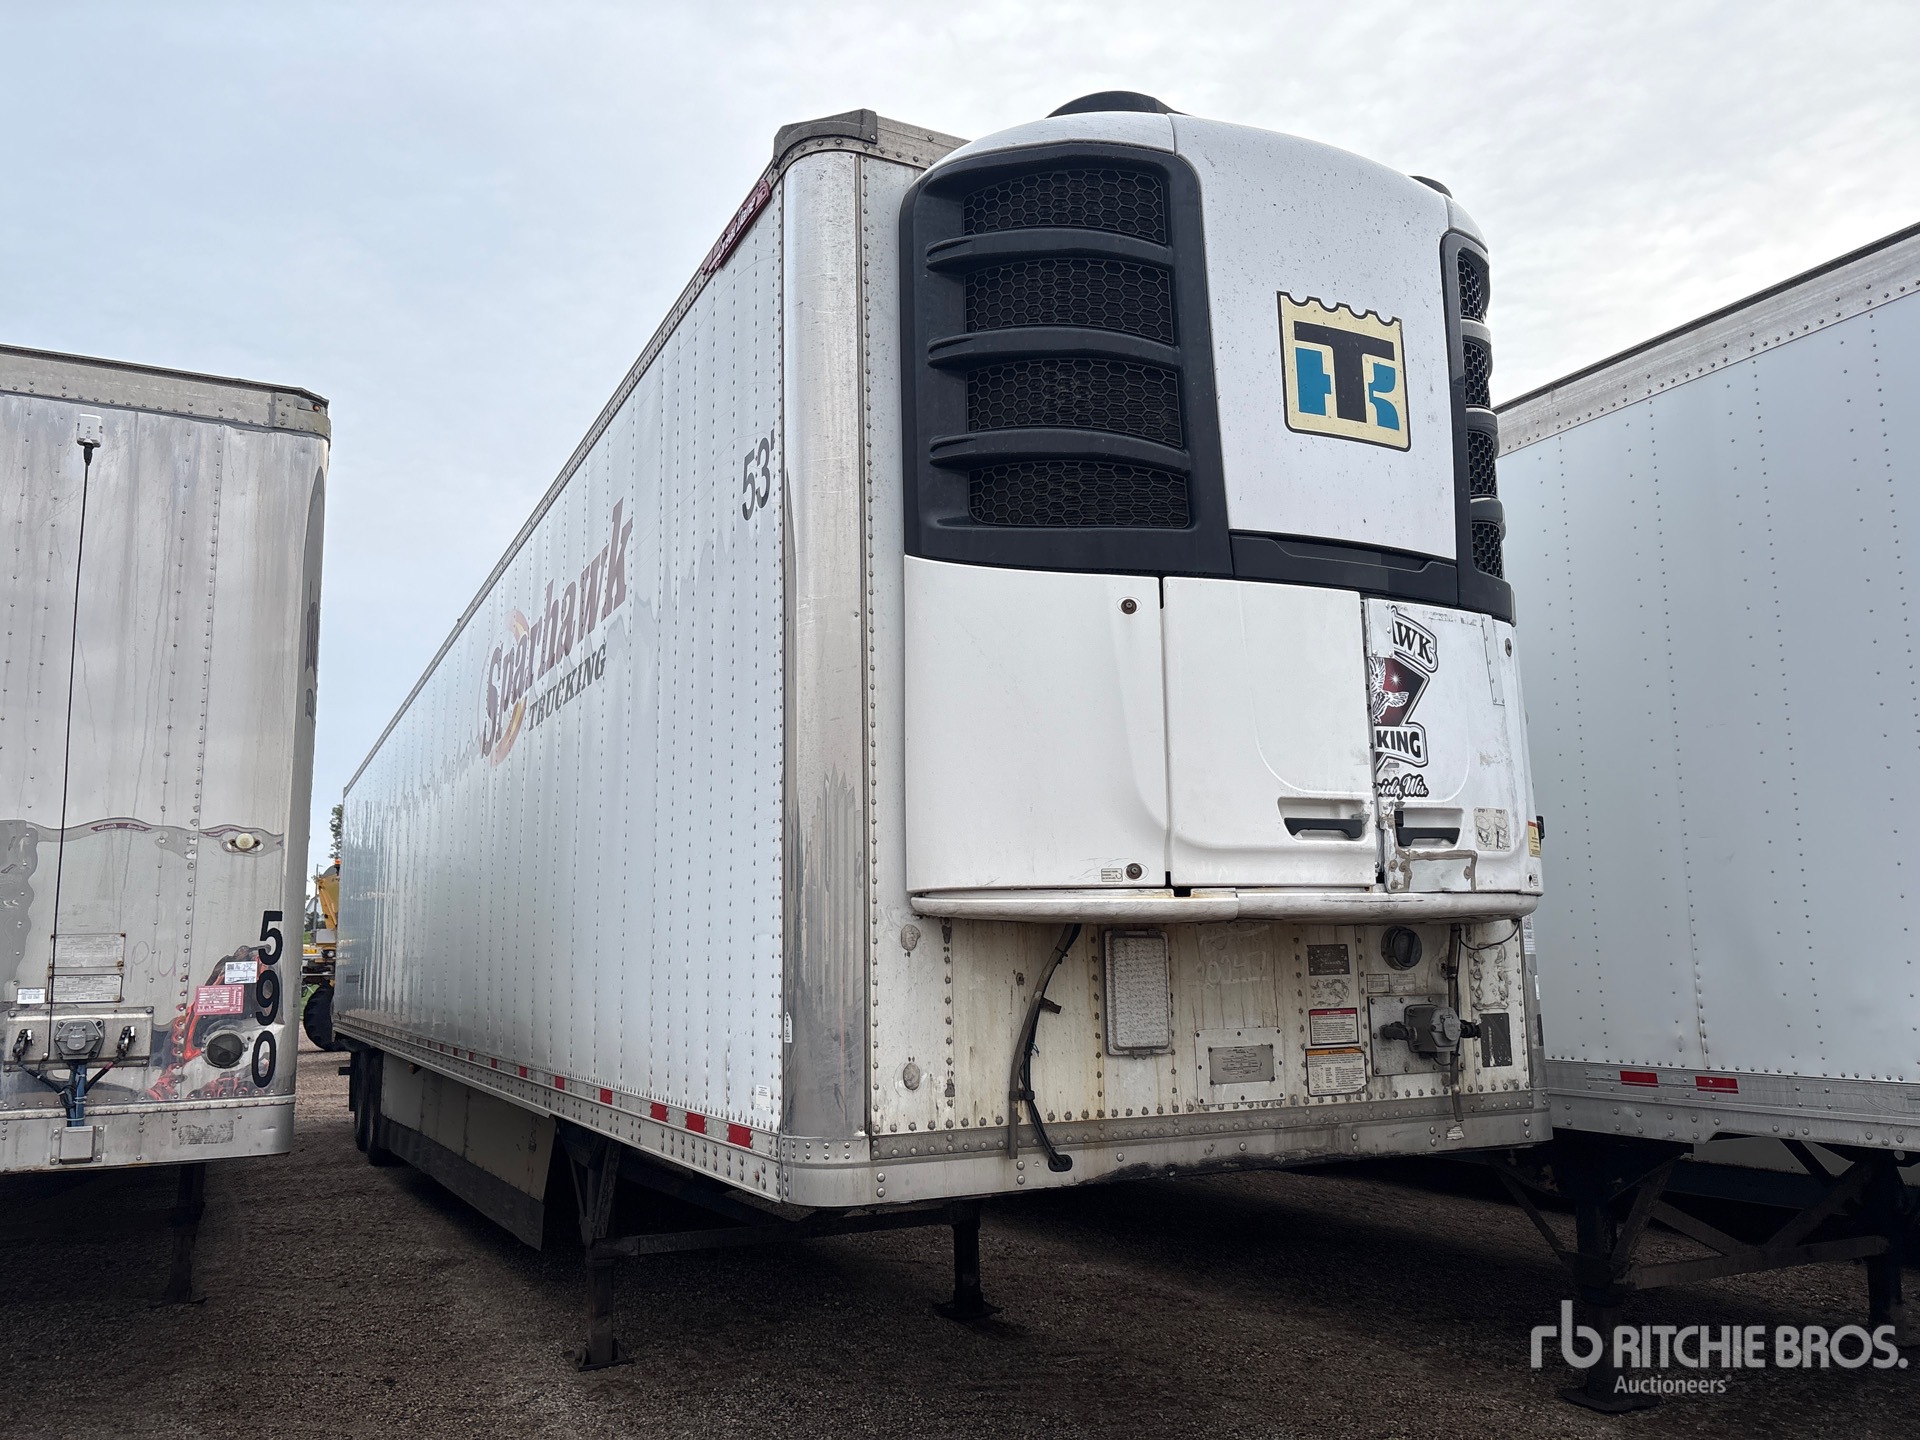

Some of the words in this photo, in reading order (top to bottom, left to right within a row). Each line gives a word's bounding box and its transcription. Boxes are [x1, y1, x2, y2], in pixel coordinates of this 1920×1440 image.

[482, 496, 633, 758] Sparhawk
[528, 643, 607, 732] TRUCKING
[251, 910, 284, 1088] 590
